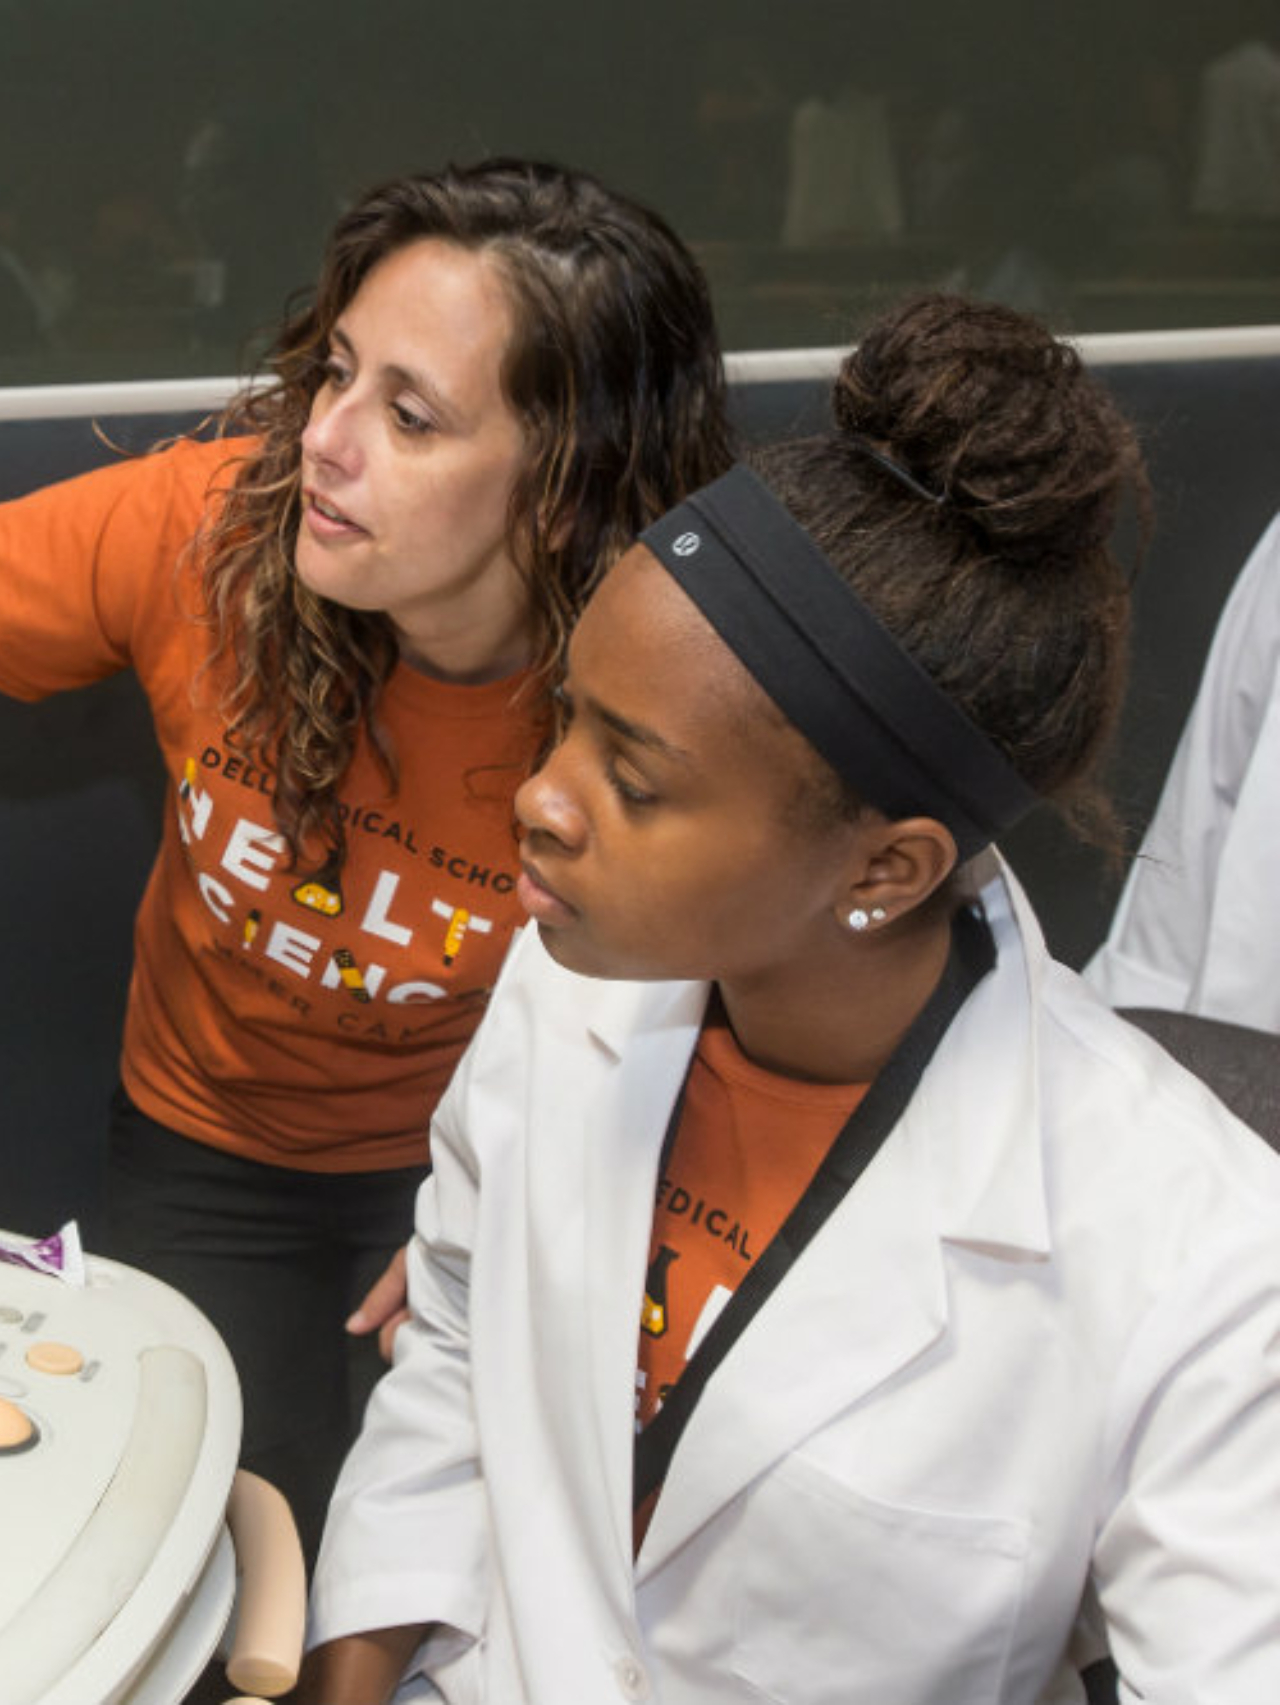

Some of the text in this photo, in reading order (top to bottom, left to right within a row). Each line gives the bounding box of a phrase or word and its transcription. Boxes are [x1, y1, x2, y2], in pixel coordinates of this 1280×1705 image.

[200, 746, 517, 894] DELL DICAL SCHO
[654, 1179, 753, 1262] EDICAL
